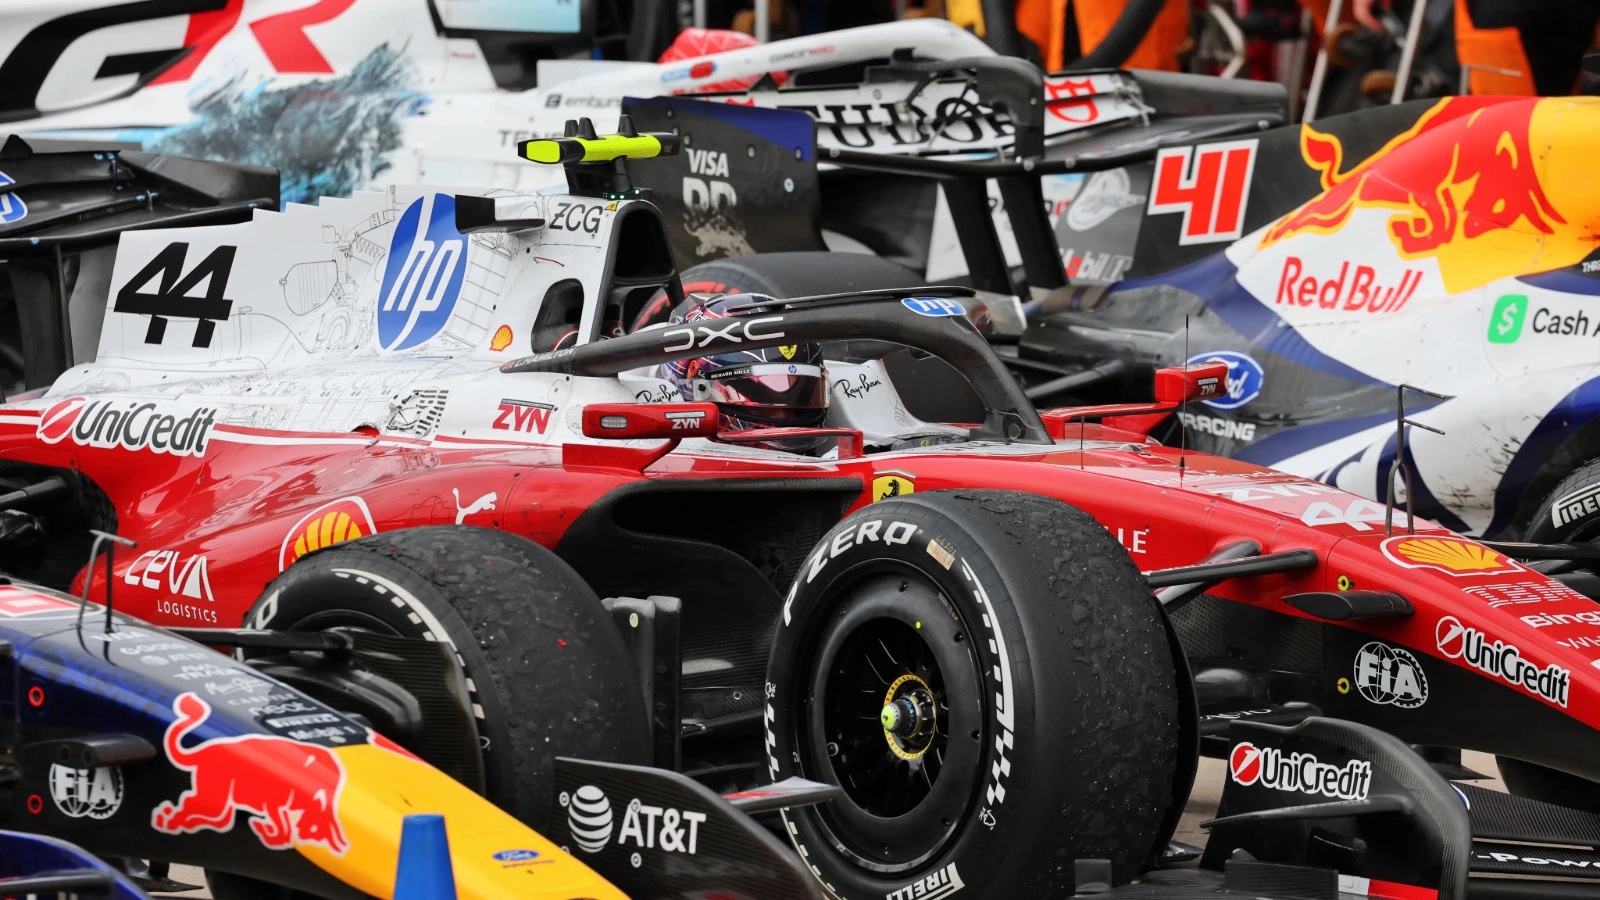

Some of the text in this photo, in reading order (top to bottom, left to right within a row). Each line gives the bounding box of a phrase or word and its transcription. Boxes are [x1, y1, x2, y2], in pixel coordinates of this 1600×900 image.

[685, 148, 729, 178] VISA
[1148, 140, 1258, 245] 41
[549, 202, 603, 234] ZCG
[382, 193, 463, 350] hp
[1276, 256, 1424, 314] Red Bull
[114, 241, 238, 348] 44
[663, 316, 785, 353] DXC
[1532, 307, 1589, 335] Cash
[1200, 384, 1216, 396] ZYN
[75, 401, 216, 453] UniCredit
[492, 404, 552, 435] ZYN
[672, 418, 700, 430] ZYN
[1177, 411, 1256, 441] RACING
[807, 519, 918, 583] ZERO
[157, 599, 217, 623] LOGISTICS
[1465, 630, 1569, 706] UniCredit
[1261, 749, 1371, 798] UniCredit
[618, 803, 707, 855] AT&T
